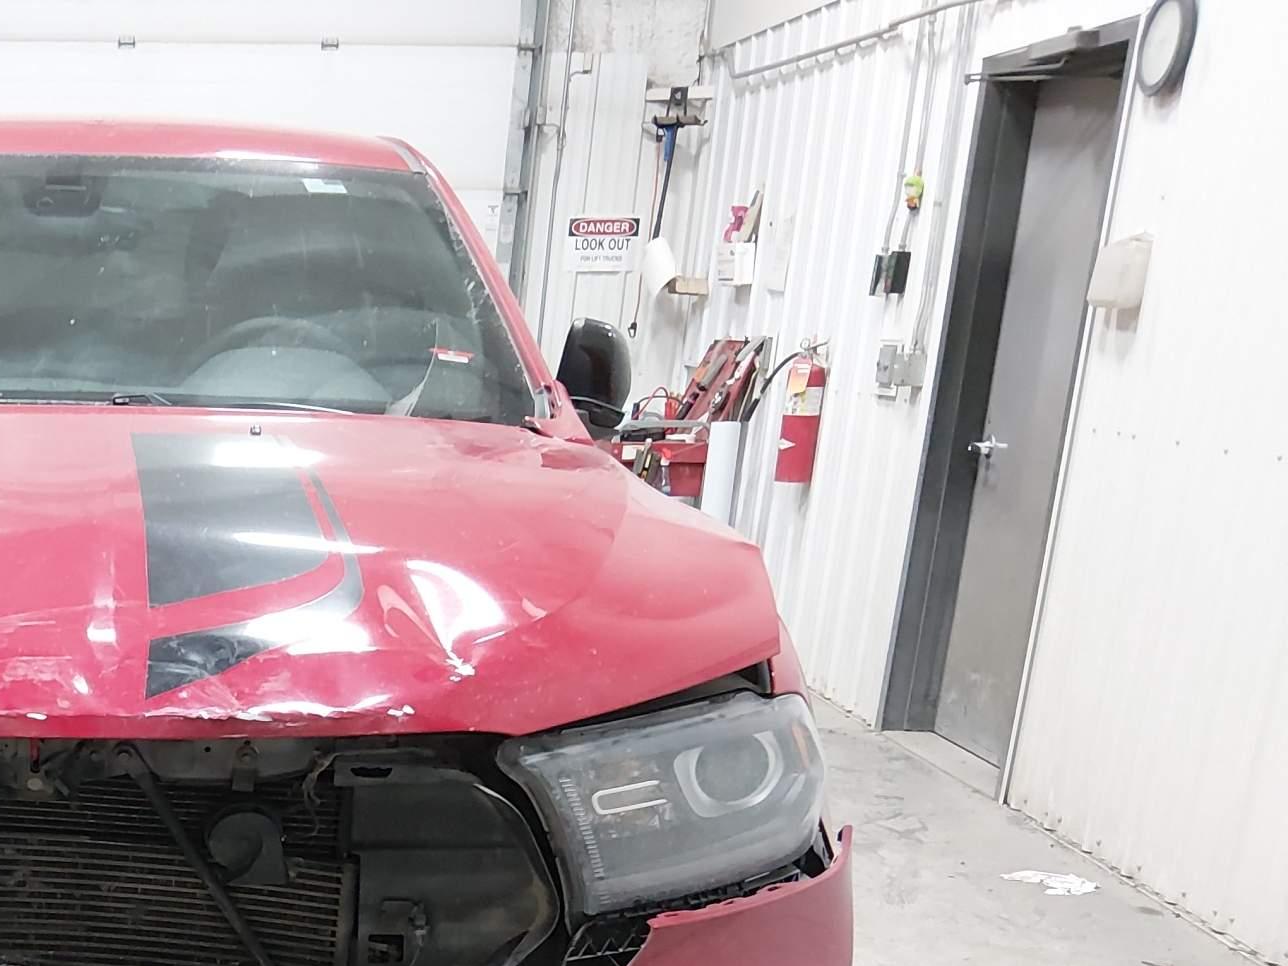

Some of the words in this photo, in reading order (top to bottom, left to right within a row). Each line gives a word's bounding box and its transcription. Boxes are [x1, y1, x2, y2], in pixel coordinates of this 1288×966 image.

[579, 221, 630, 233] DANGER
[575, 238, 605, 251] LOOK
[608, 238, 631, 251] OUT
